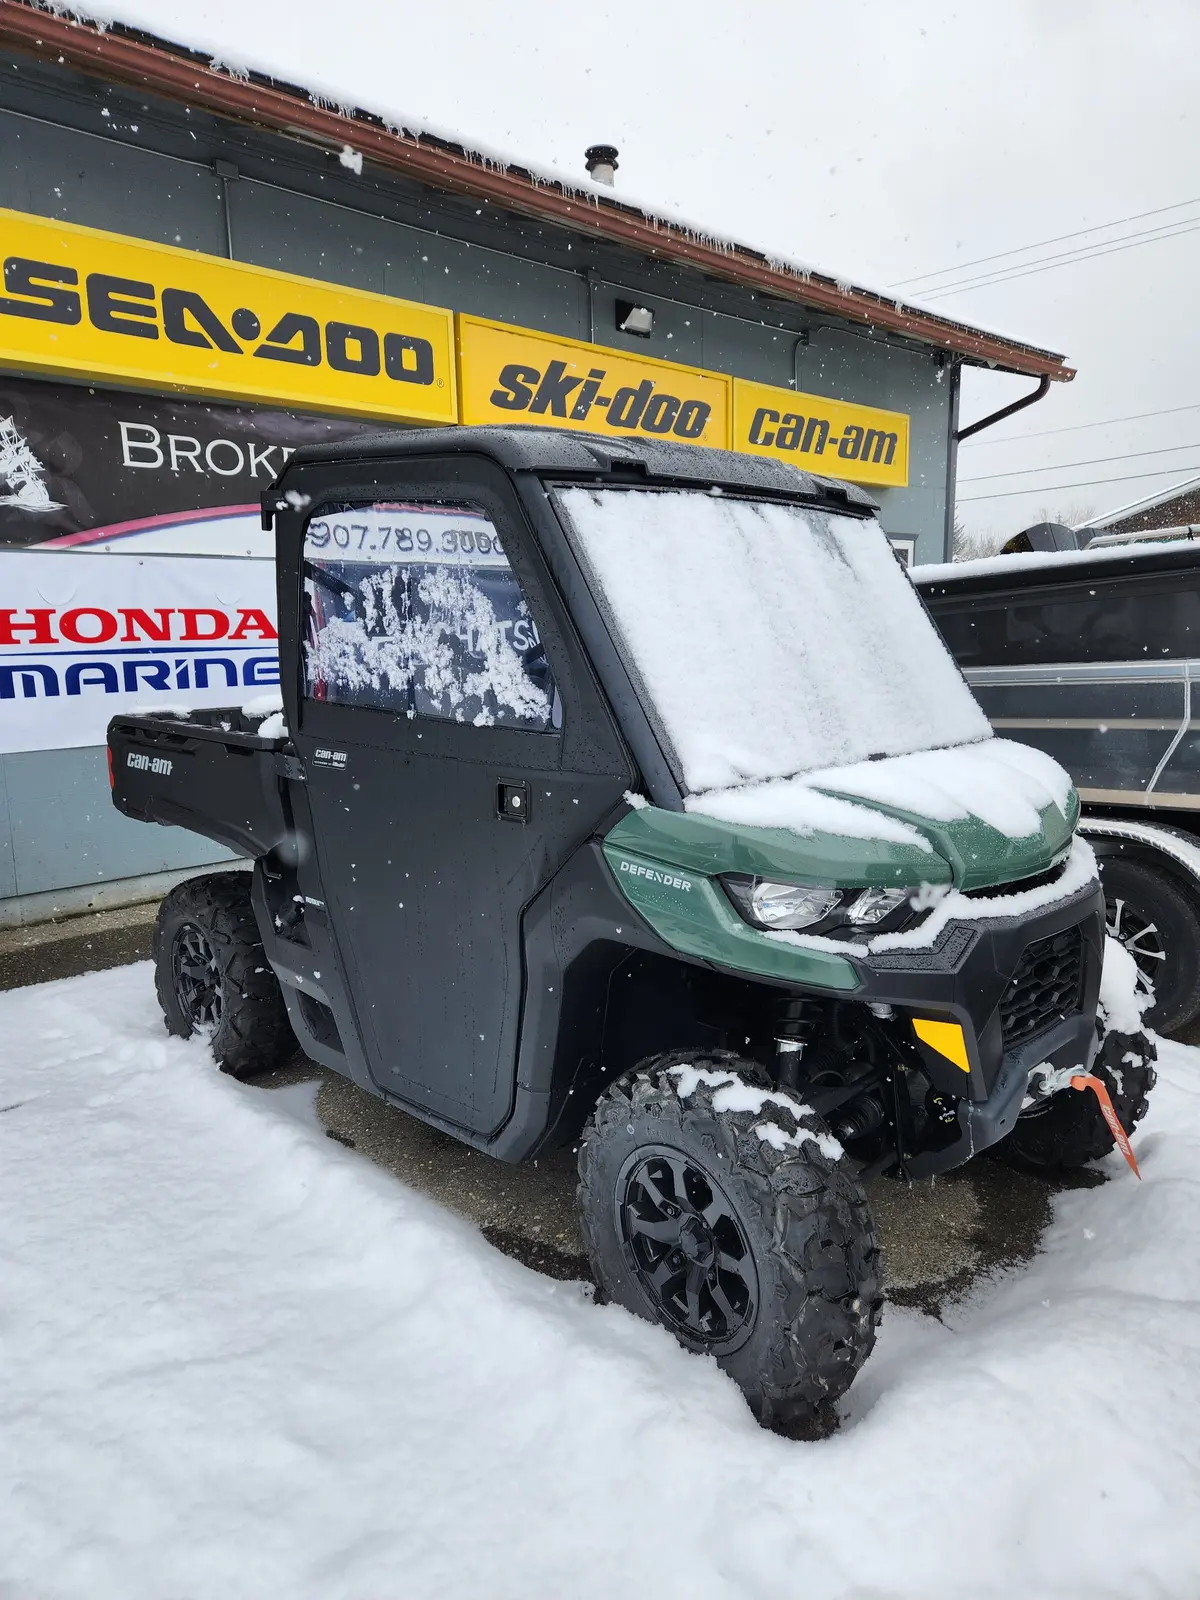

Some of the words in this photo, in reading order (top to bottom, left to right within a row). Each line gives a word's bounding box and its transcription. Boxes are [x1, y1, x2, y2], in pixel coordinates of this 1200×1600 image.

[489, 360, 712, 439] ski-doo
[748, 407, 898, 465] can-am
[0, 607, 279, 645] HONDA
[126, 752, 173, 776] can-am
[315, 749, 347, 762] can-am
[620, 861, 692, 892] DEFENDER
